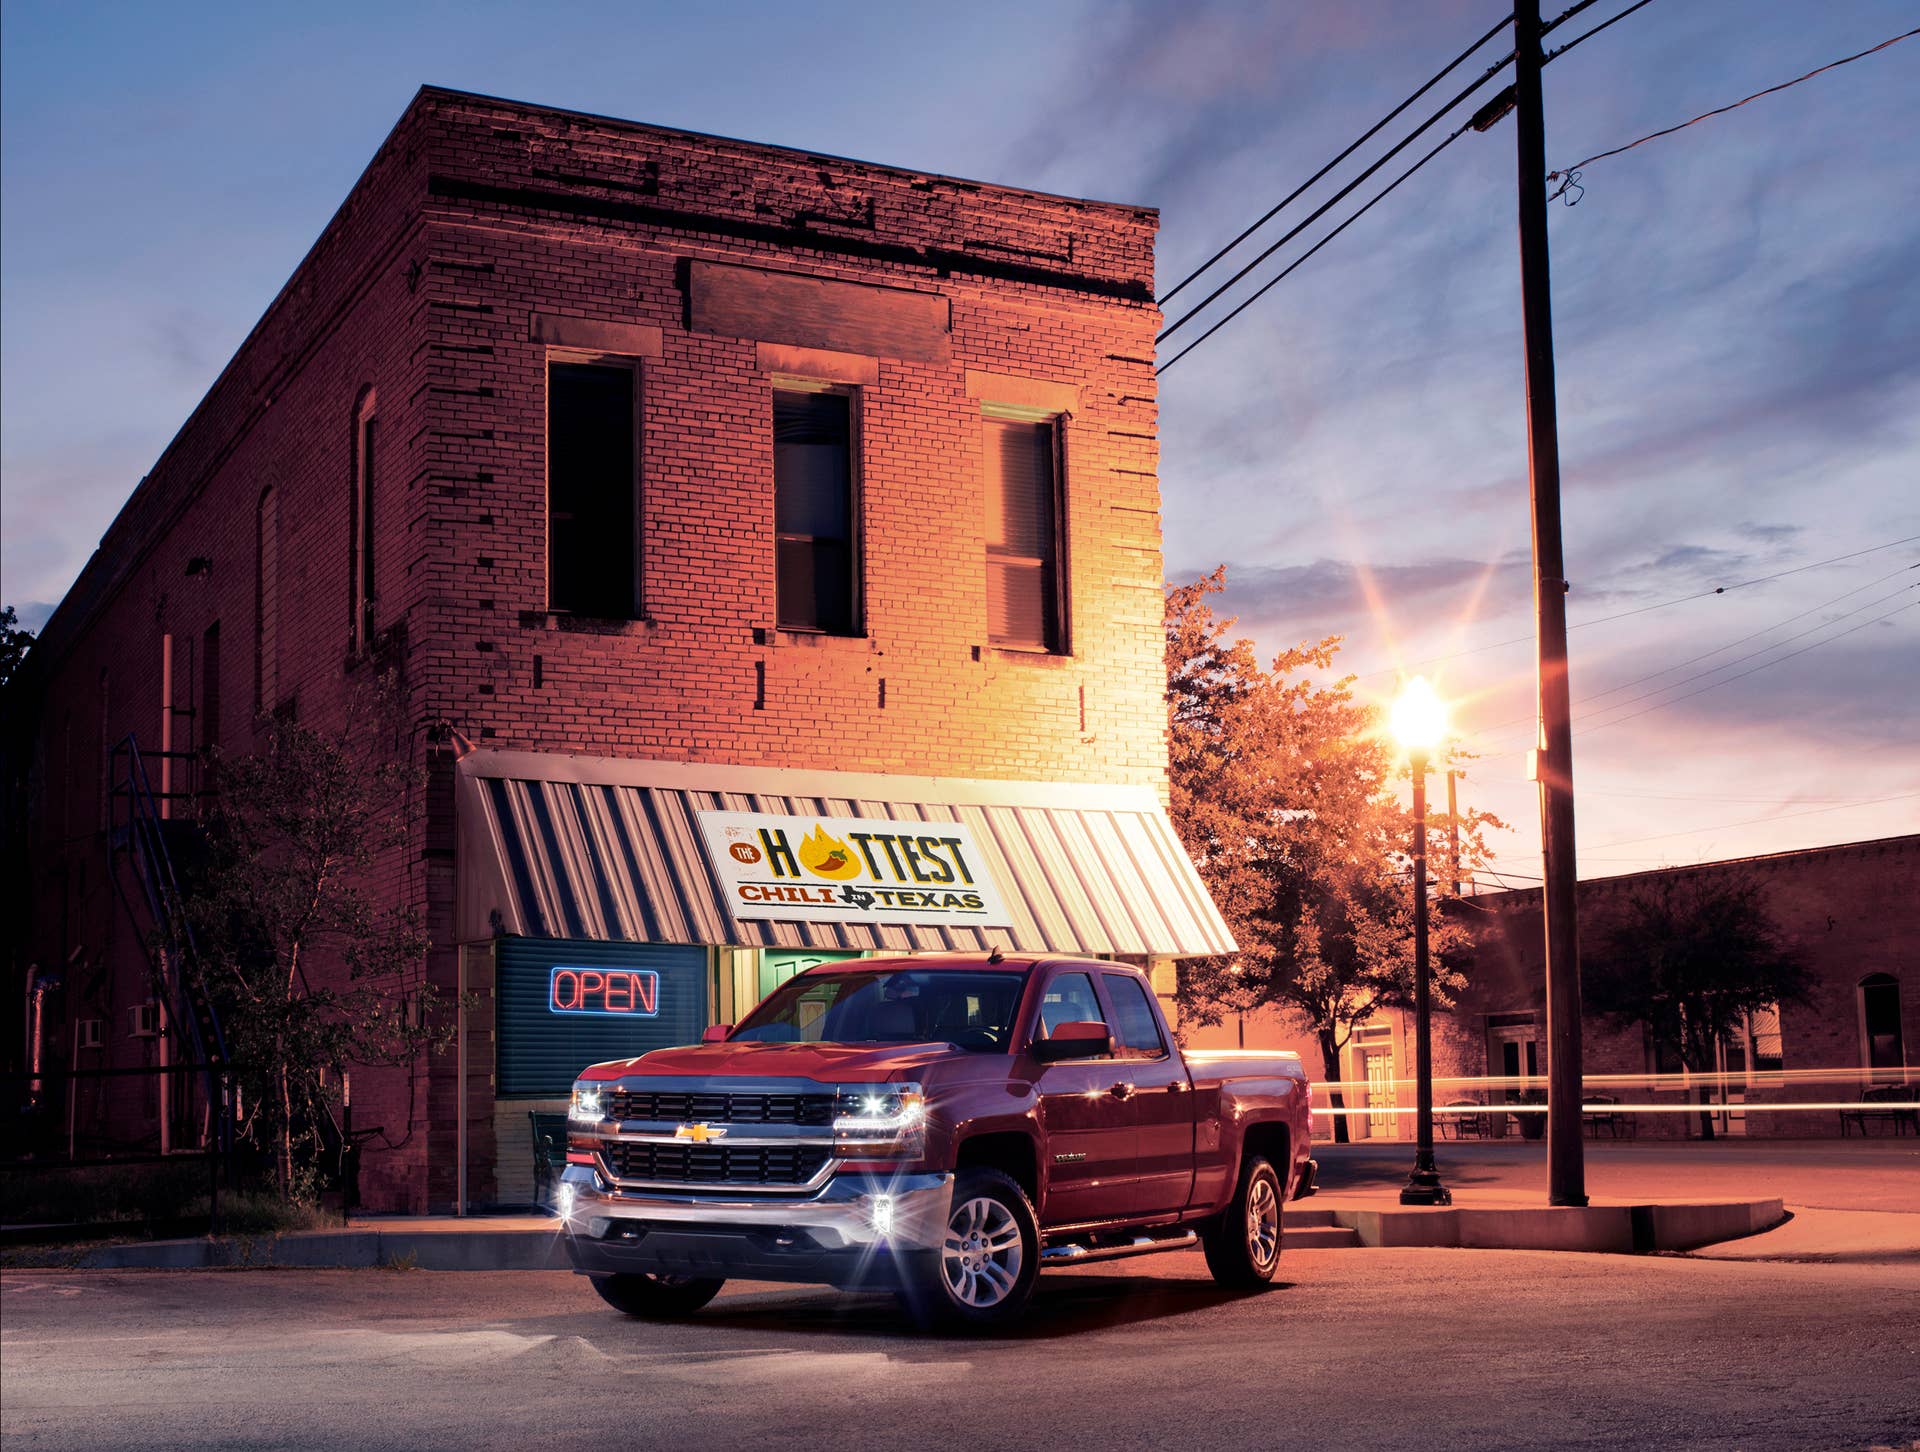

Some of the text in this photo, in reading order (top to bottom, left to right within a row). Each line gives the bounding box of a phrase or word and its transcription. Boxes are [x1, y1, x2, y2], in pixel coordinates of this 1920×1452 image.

[735, 822, 975, 885] THE HOTTEST
[738, 885, 985, 909] CHILI IN TEXAS
[554, 970, 655, 1012] OPEN
